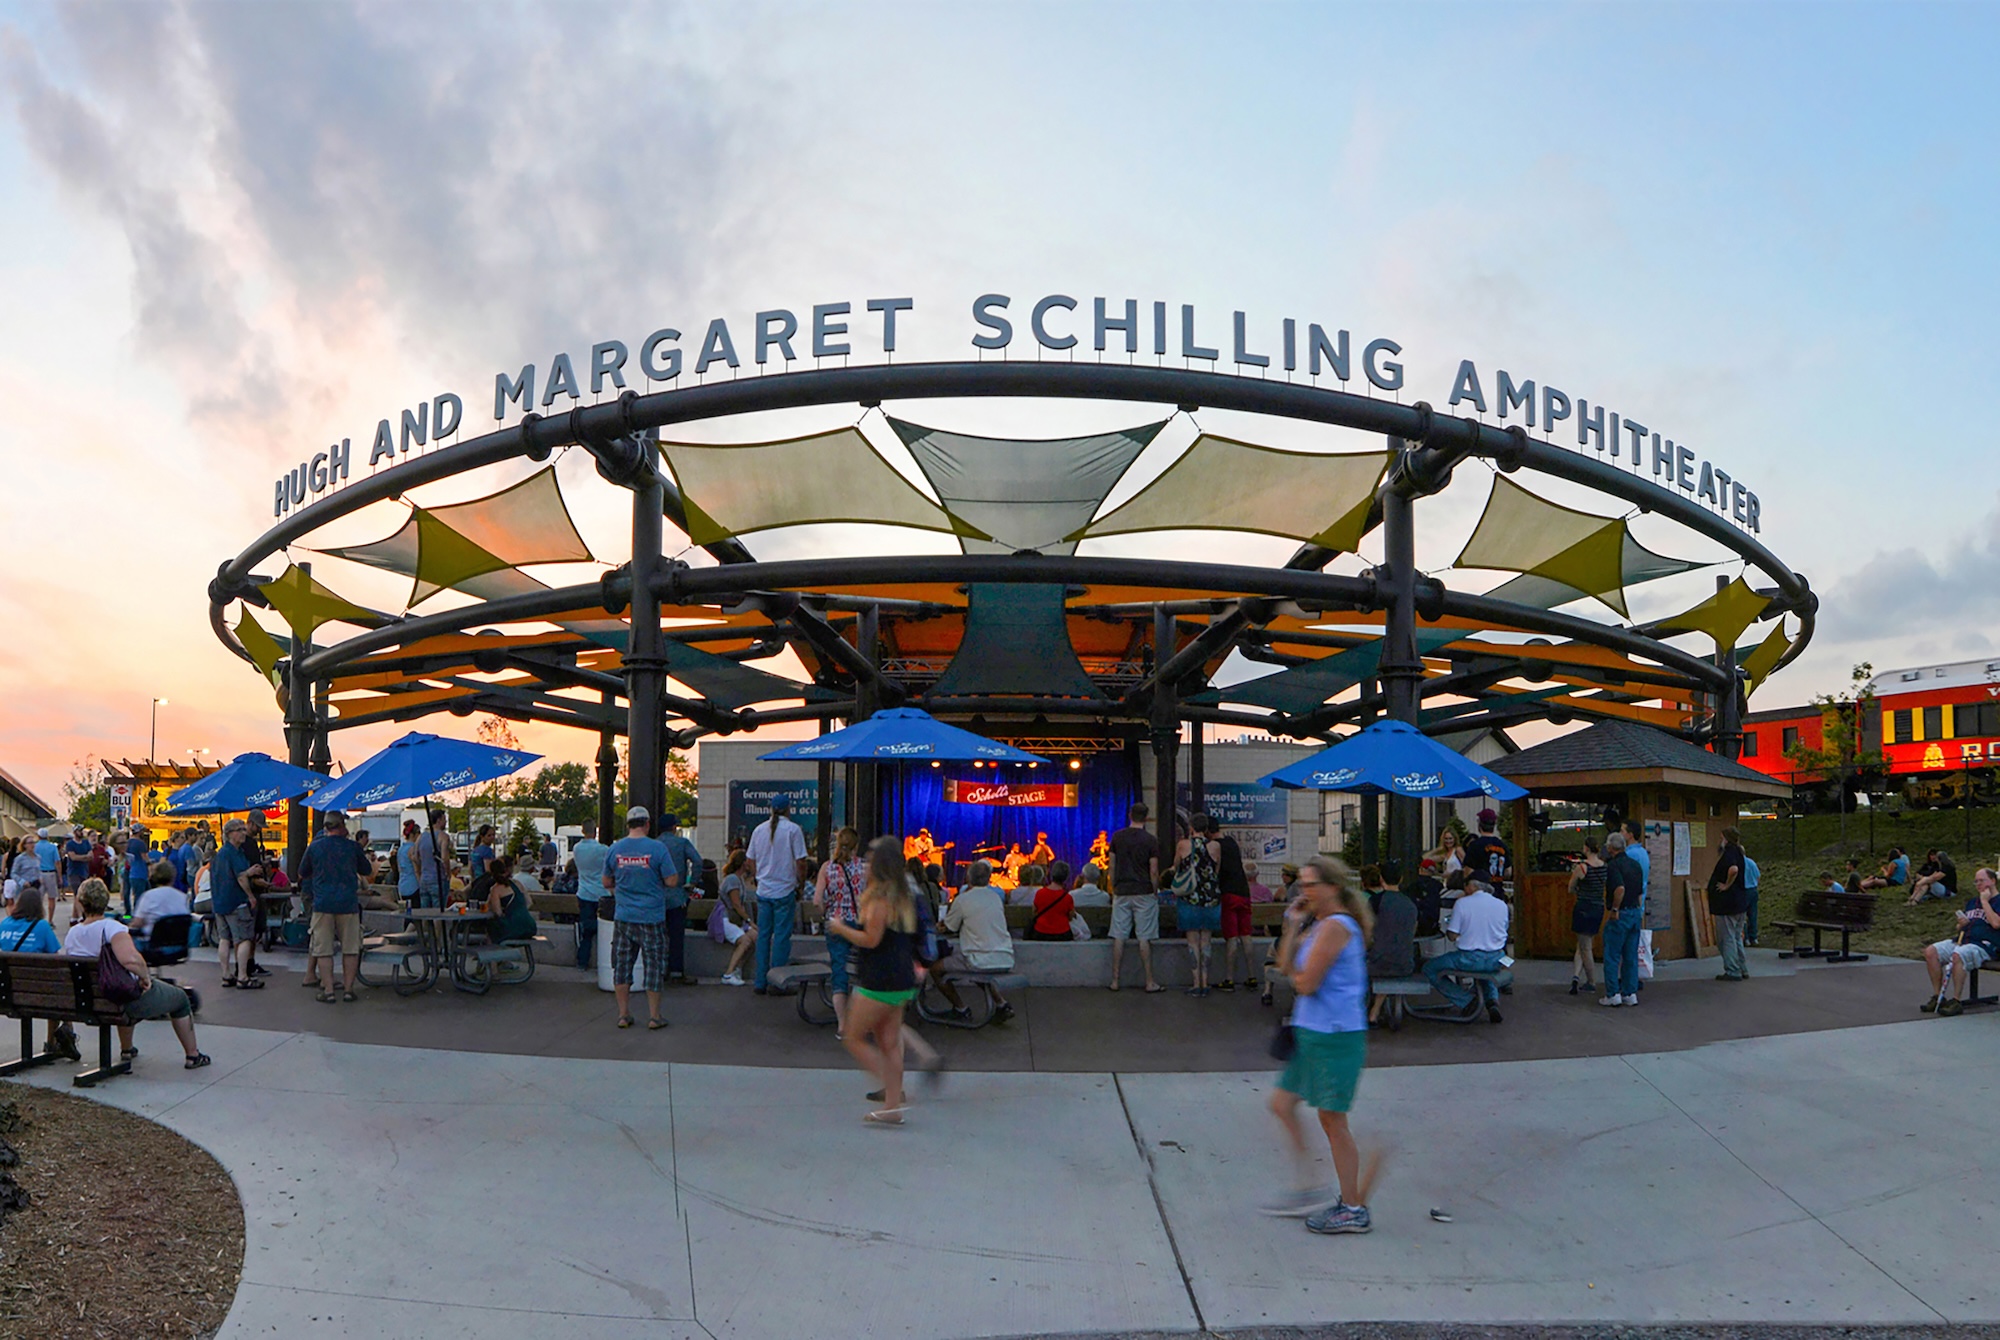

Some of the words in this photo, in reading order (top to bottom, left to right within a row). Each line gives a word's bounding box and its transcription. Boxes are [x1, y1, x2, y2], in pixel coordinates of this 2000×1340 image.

[274, 438, 350, 517] HUGH
[369, 392, 463, 466] AND
[494, 297, 913, 420] MARGARET
[971, 293, 1404, 391] SCHILLING
[1448, 359, 1761, 534] AMPHITHEATER
[112, 795, 131, 806] BLU
[1008, 790, 1046, 806] STAGE
[1240, 792, 1275, 803] brewed
[745, 804, 797, 815] Minna
[1227, 810, 1254, 821] years
